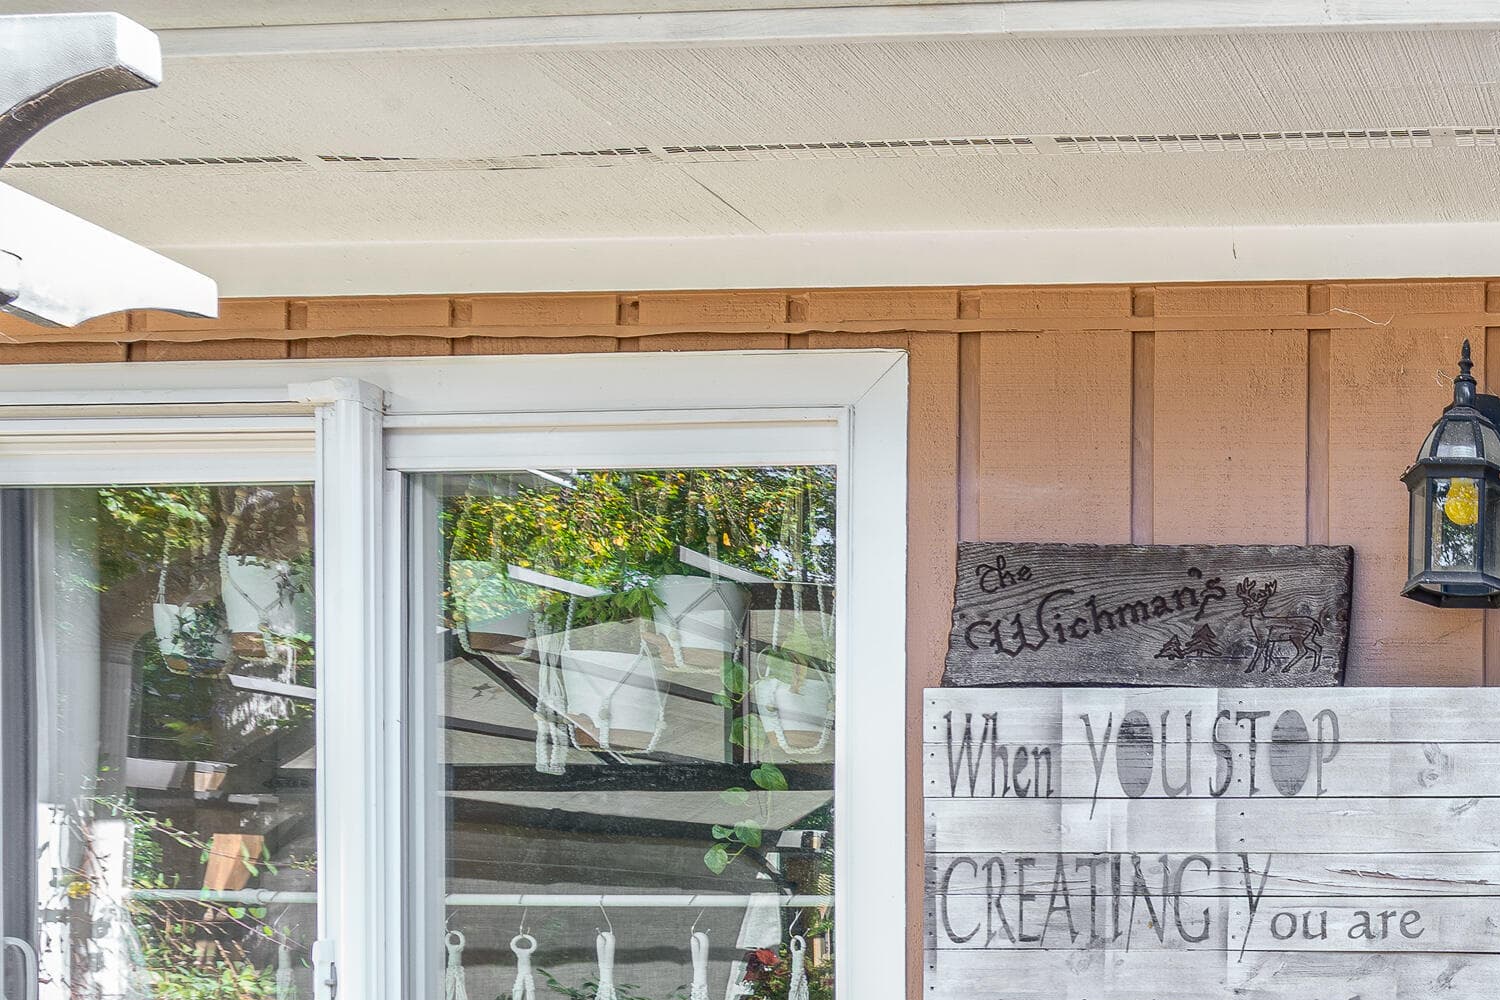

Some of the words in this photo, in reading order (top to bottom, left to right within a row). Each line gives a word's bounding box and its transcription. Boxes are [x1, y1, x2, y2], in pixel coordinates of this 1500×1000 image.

[964, 566, 1226, 657] Wichman's
[975, 554, 1033, 594] The
[942, 711, 1054, 799] When
[1080, 709, 1193, 820] YOU
[1209, 709, 1340, 799] STOP
[941, 852, 1213, 952] CREATING
[1347, 906, 1426, 941] are
